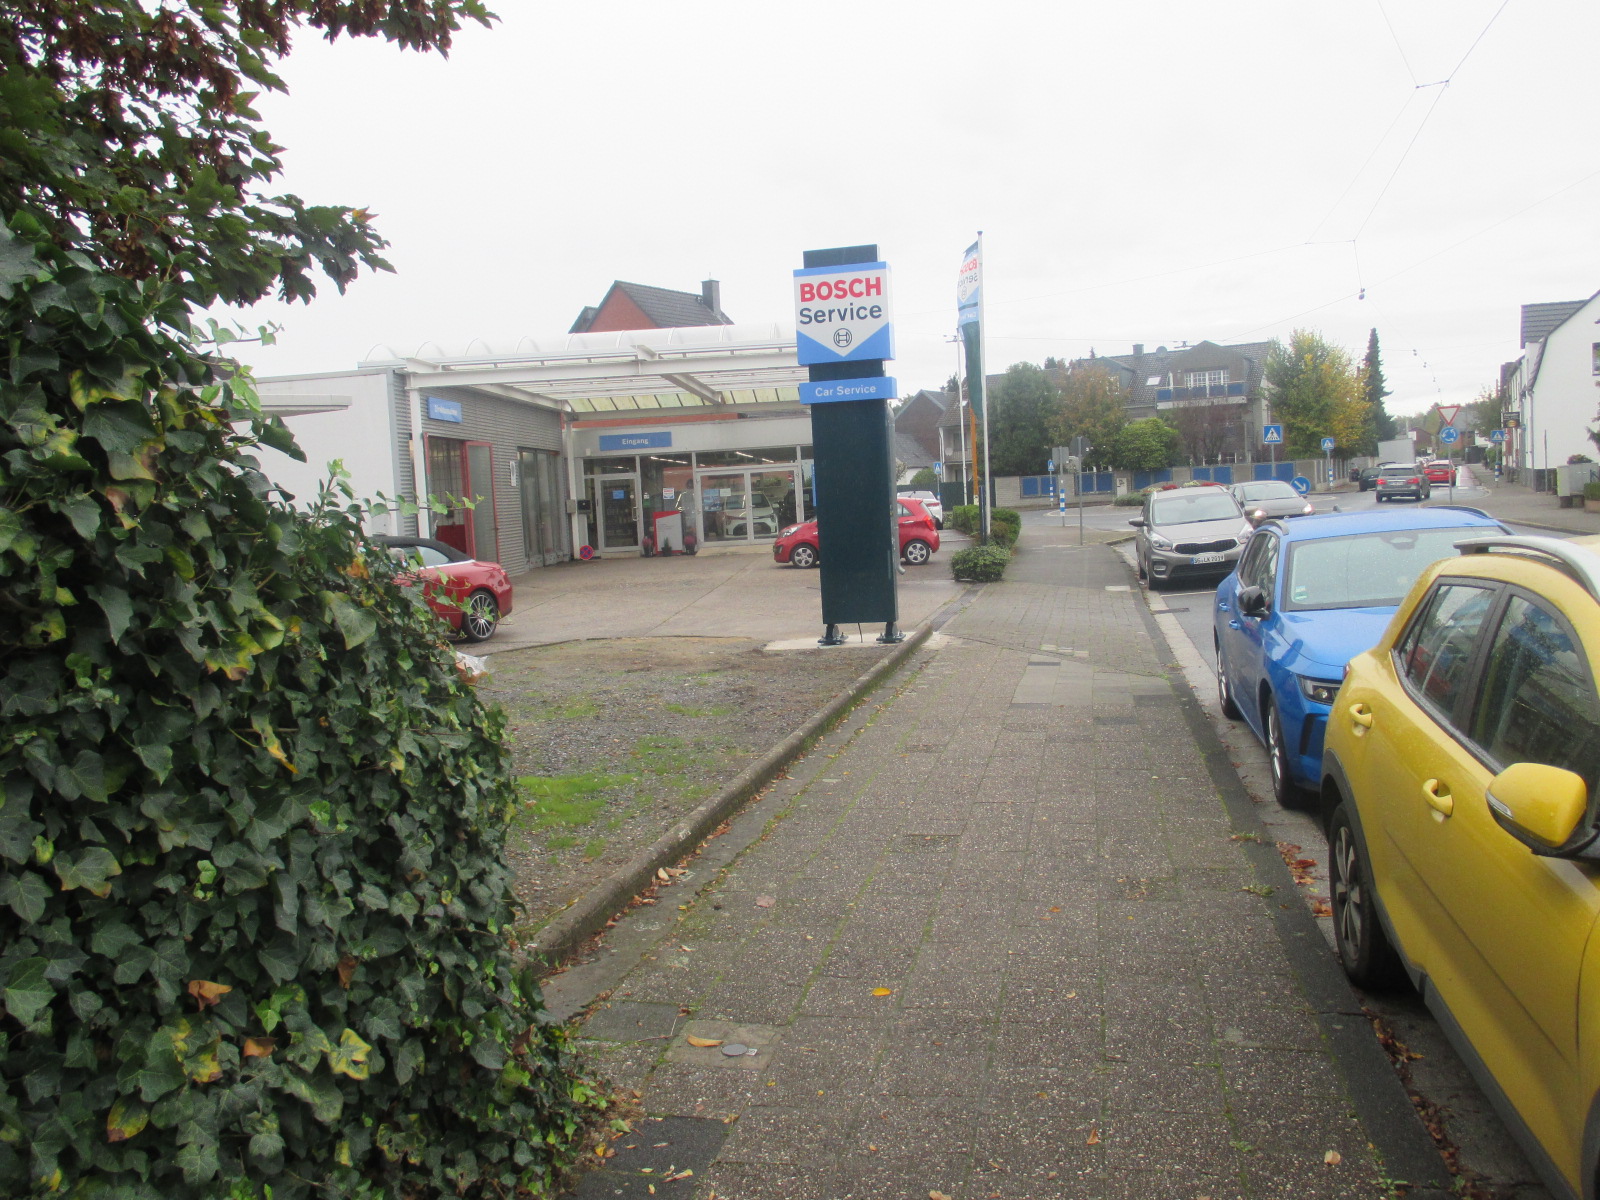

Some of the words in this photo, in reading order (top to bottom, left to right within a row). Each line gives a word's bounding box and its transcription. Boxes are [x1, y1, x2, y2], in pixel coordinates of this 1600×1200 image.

[799, 276, 882, 302] BOSCH
[799, 302, 882, 325] Service
[815, 387, 833, 397] Car
[836, 384, 877, 396] Service
